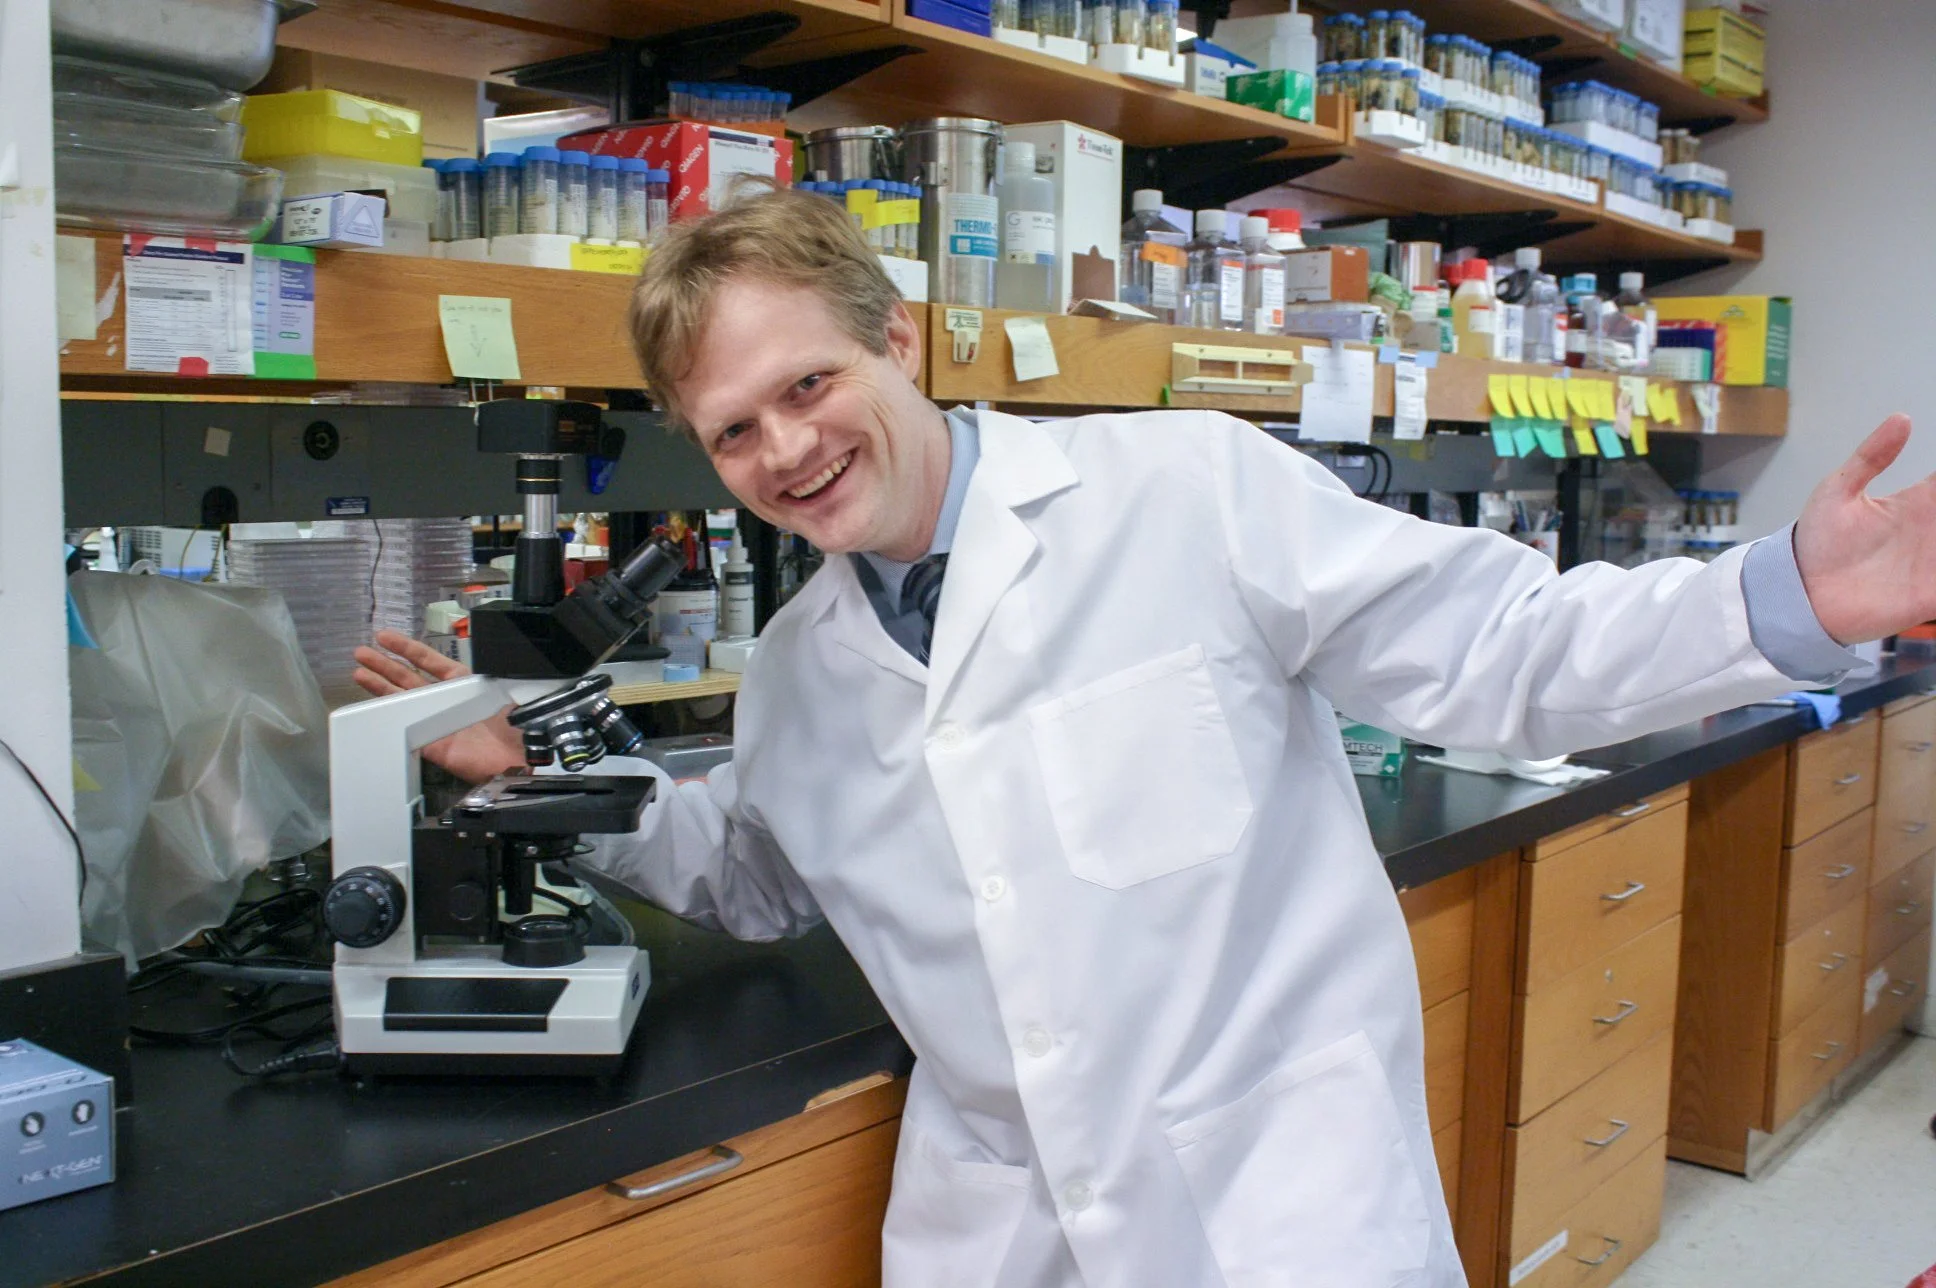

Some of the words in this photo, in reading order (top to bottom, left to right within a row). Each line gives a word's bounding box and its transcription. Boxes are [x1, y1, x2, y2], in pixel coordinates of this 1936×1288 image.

[679, 144, 704, 173] QIAGEN
[954, 218, 998, 235] THERMO-
[1343, 742, 1382, 751] MTECH
